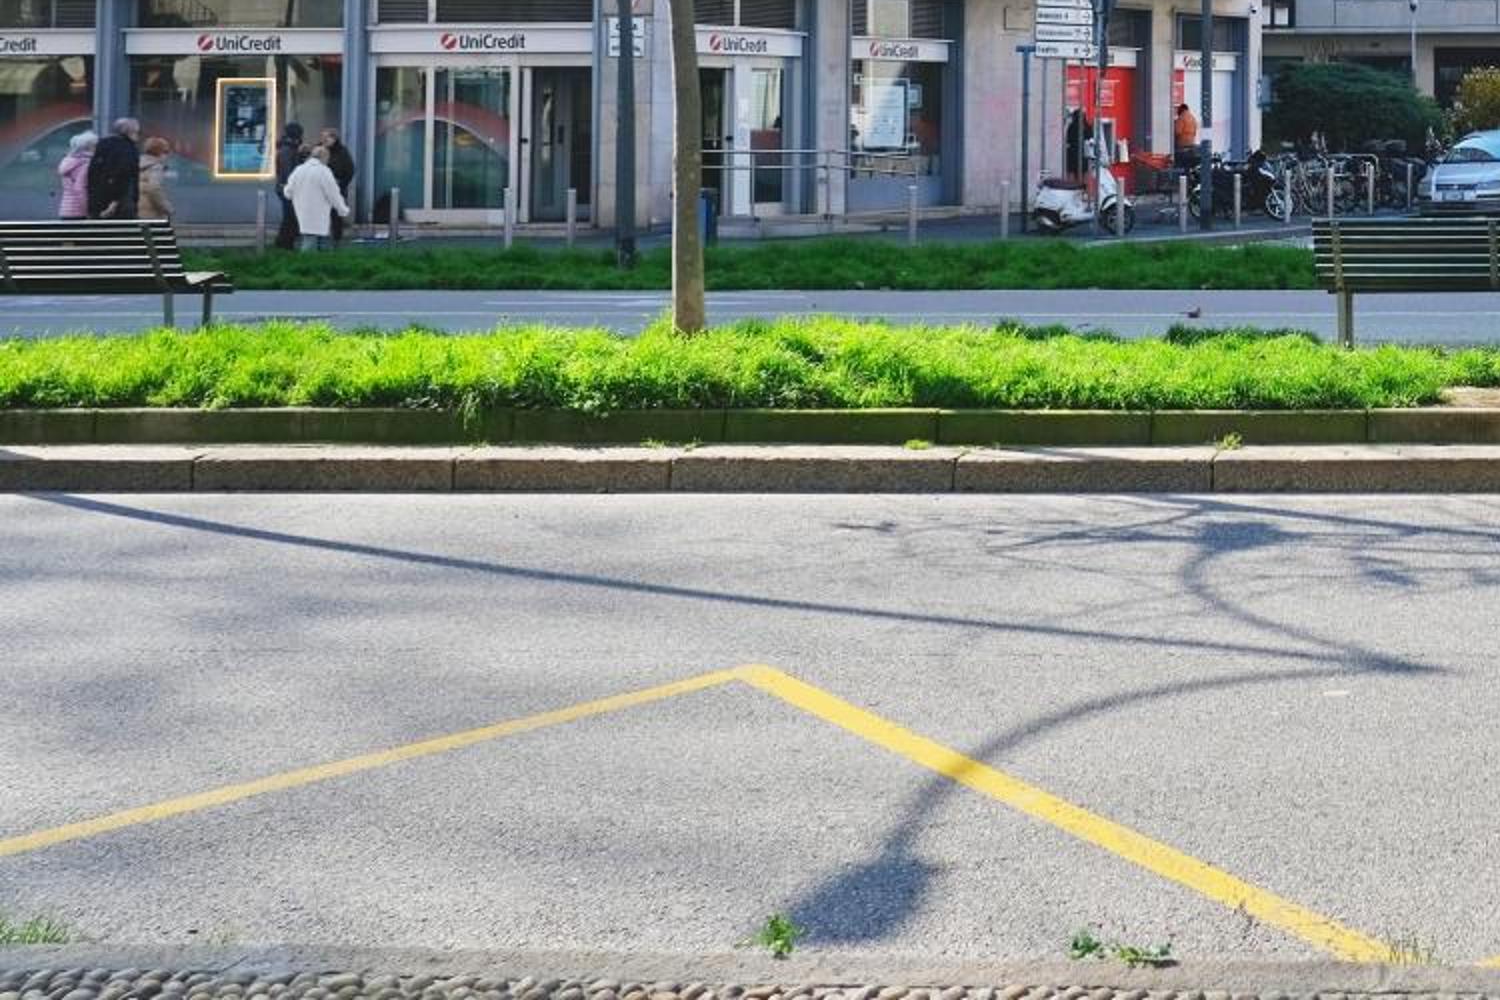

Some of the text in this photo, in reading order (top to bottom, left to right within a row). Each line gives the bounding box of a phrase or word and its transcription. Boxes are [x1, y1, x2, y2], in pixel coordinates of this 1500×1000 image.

[215, 35, 282, 51] UniCredit
[459, 33, 526, 49] UniCredit
[723, 36, 768, 53] UniCredit
